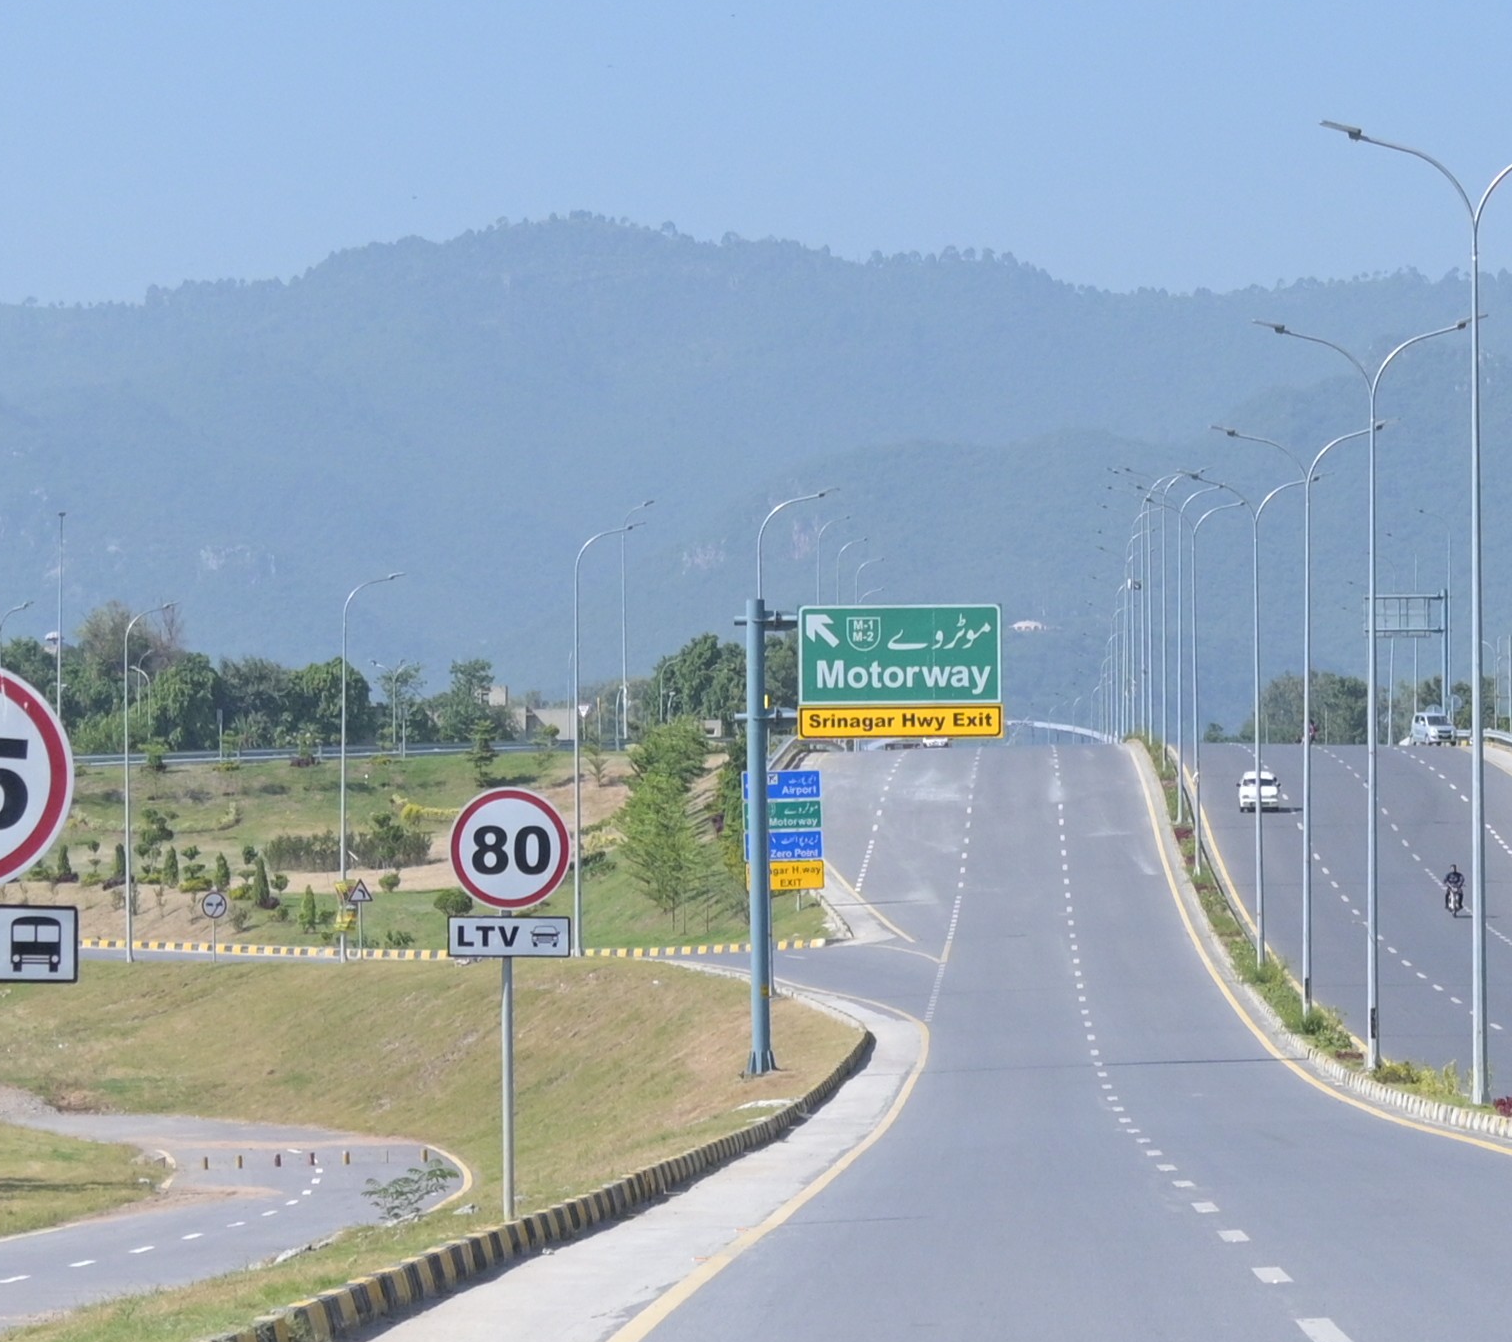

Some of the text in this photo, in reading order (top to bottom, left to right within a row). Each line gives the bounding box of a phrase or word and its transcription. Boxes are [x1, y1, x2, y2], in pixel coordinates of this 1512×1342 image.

[853, 619, 874, 630] M-1
[852, 631, 874, 642] M-2
[816, 660, 992, 695] Motorway
[809, 712, 992, 732] Srinagar Hwy Exit
[781, 785, 817, 796] Airport
[769, 817, 818, 827] Motorway
[472, 825, 552, 876] 80
[770, 848, 819, 858] Zero Point
[780, 878, 803, 888] EXIT
[457, 925, 520, 948] LTV
